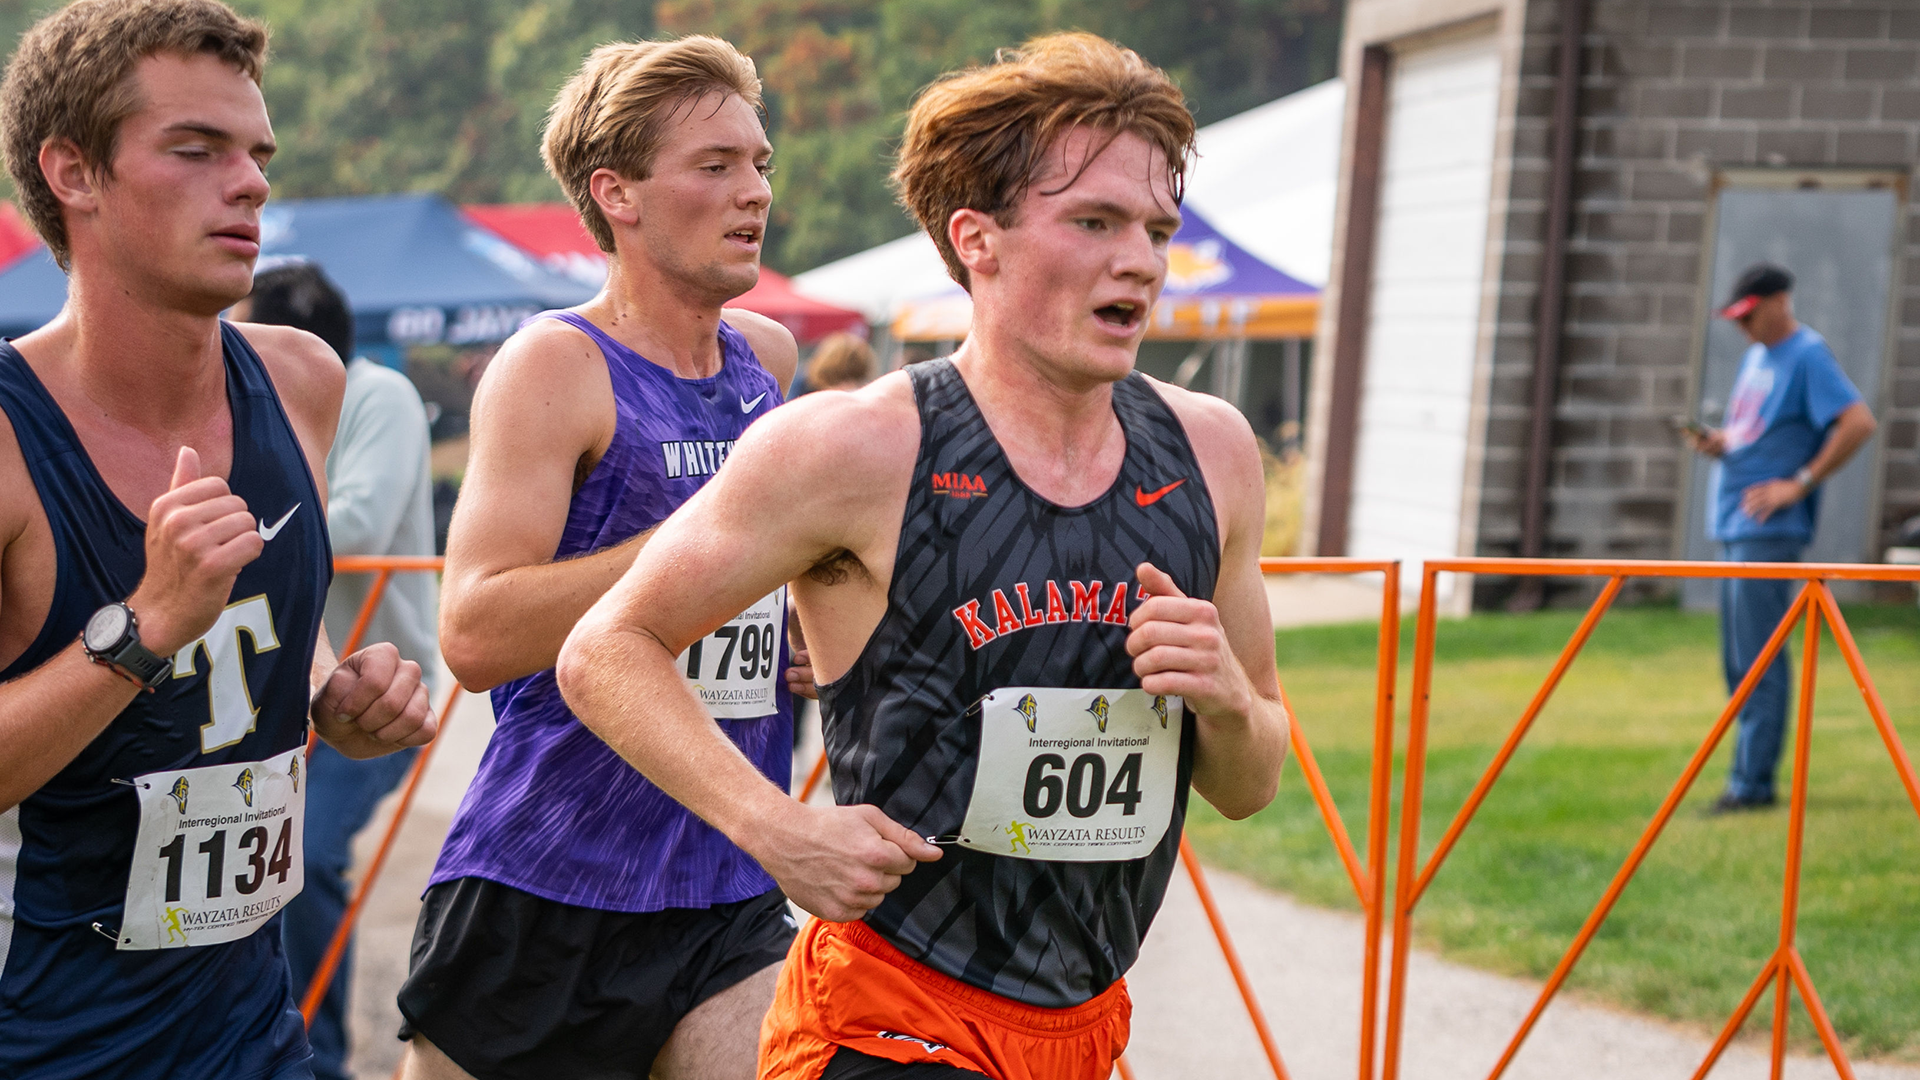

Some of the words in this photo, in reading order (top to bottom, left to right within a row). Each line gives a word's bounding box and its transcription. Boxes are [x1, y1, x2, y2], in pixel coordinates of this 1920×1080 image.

[932, 471, 988, 492] MIAA
[686, 622, 775, 681] 1799
[172, 593, 281, 755] T
[700, 689, 744, 700] WAYZATA
[1029, 737, 1095, 750] Interregional
[1097, 735, 1150, 747] Invitational
[1023, 752, 1144, 819] 604
[178, 813, 243, 830] Interregional
[244, 803, 287, 823] Invitational
[1028, 828, 1091, 841] WAYZATA
[1095, 825, 1147, 840] RESULTS
[159, 816, 293, 903] 1134
[182, 907, 240, 926] WAYZATA
[242, 894, 281, 918] RESULTS
